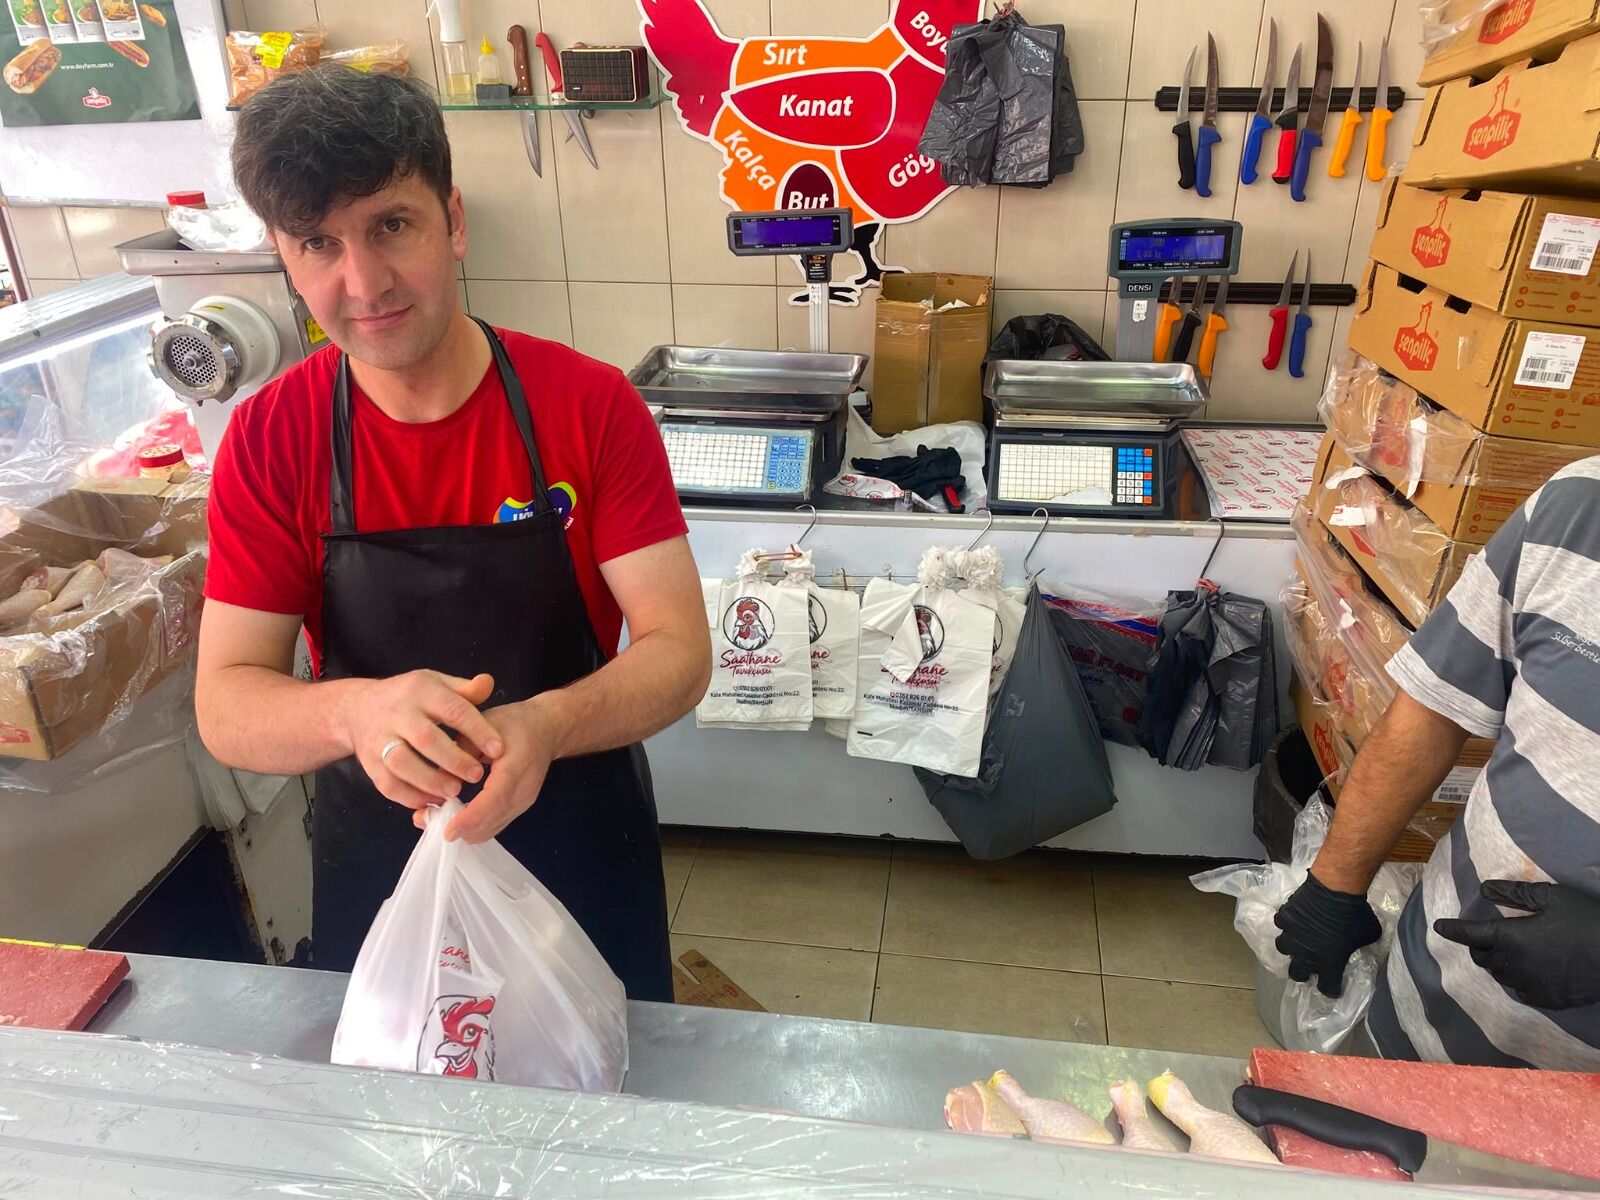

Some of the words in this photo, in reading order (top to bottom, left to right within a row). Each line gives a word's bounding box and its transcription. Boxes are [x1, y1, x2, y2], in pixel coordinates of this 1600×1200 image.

[763, 42, 808, 66] Sırt
[779, 94, 854, 117] Kanat
[723, 129, 777, 191] Kalça
[788, 190, 829, 210] But
[720, 649, 781, 668] Saathane
